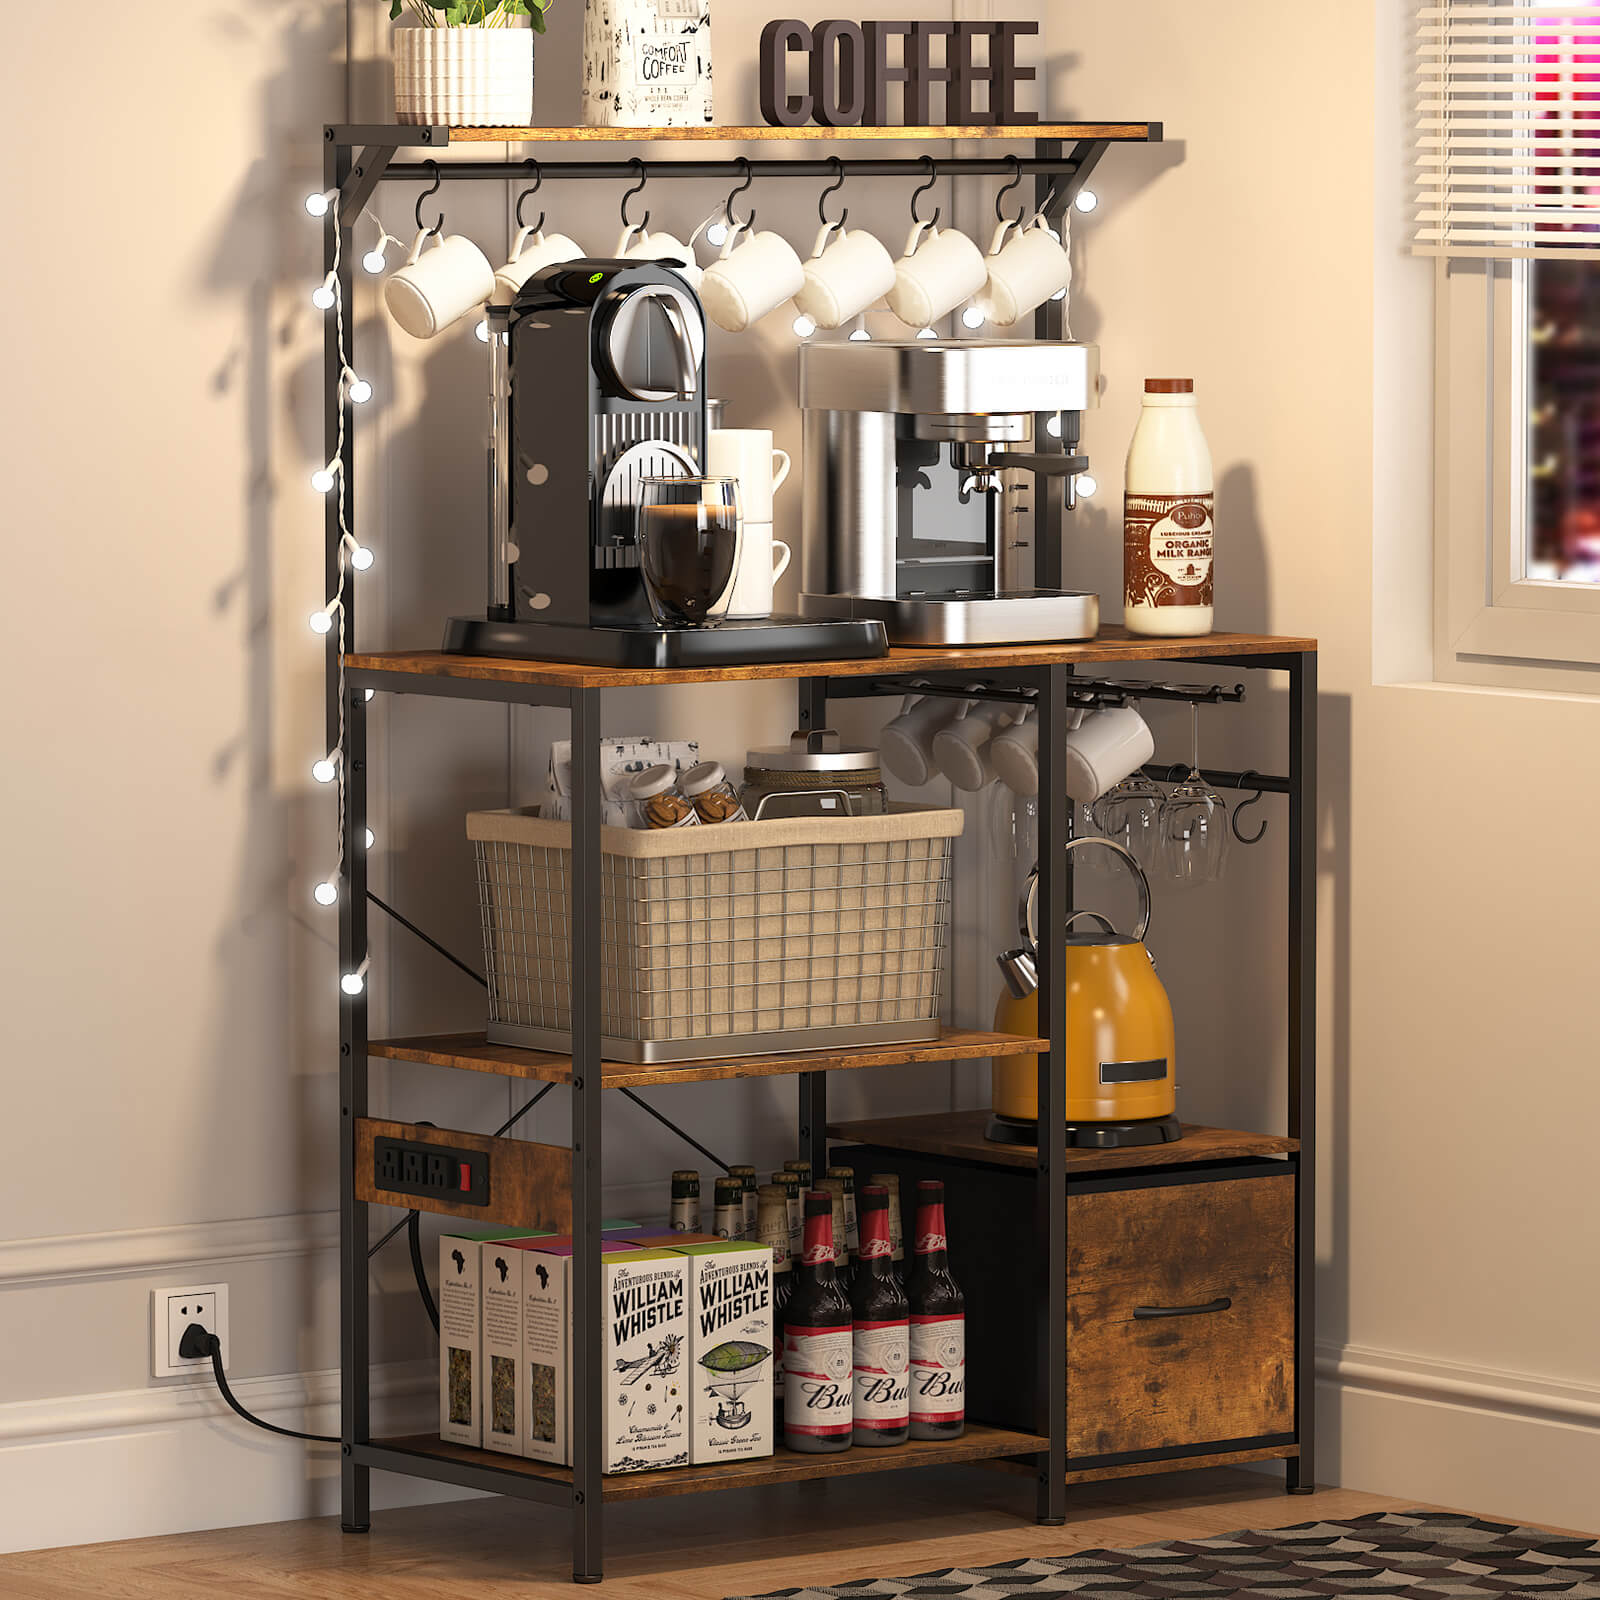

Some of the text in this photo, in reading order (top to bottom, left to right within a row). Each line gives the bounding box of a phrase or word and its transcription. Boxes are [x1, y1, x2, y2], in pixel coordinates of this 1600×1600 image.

[642, 42, 691, 64] COMFORT
[642, 56, 686, 80] COFFEE
[759, 18, 1039, 126] COFFEE
[1157, 549, 1184, 558] MILK
[1165, 539, 1210, 549] ORGANIC
[617, 1267, 630, 1279] The
[654, 1270, 674, 1281] BLENDS
[704, 1259, 716, 1271] The
[740, 1261, 760, 1272] BLENDS
[613, 1279, 683, 1319] WILLIAM
[699, 1270, 769, 1310] WILLIAM
[613, 1299, 683, 1347] WHISTLE
[700, 1290, 769, 1338] WHISTLE
